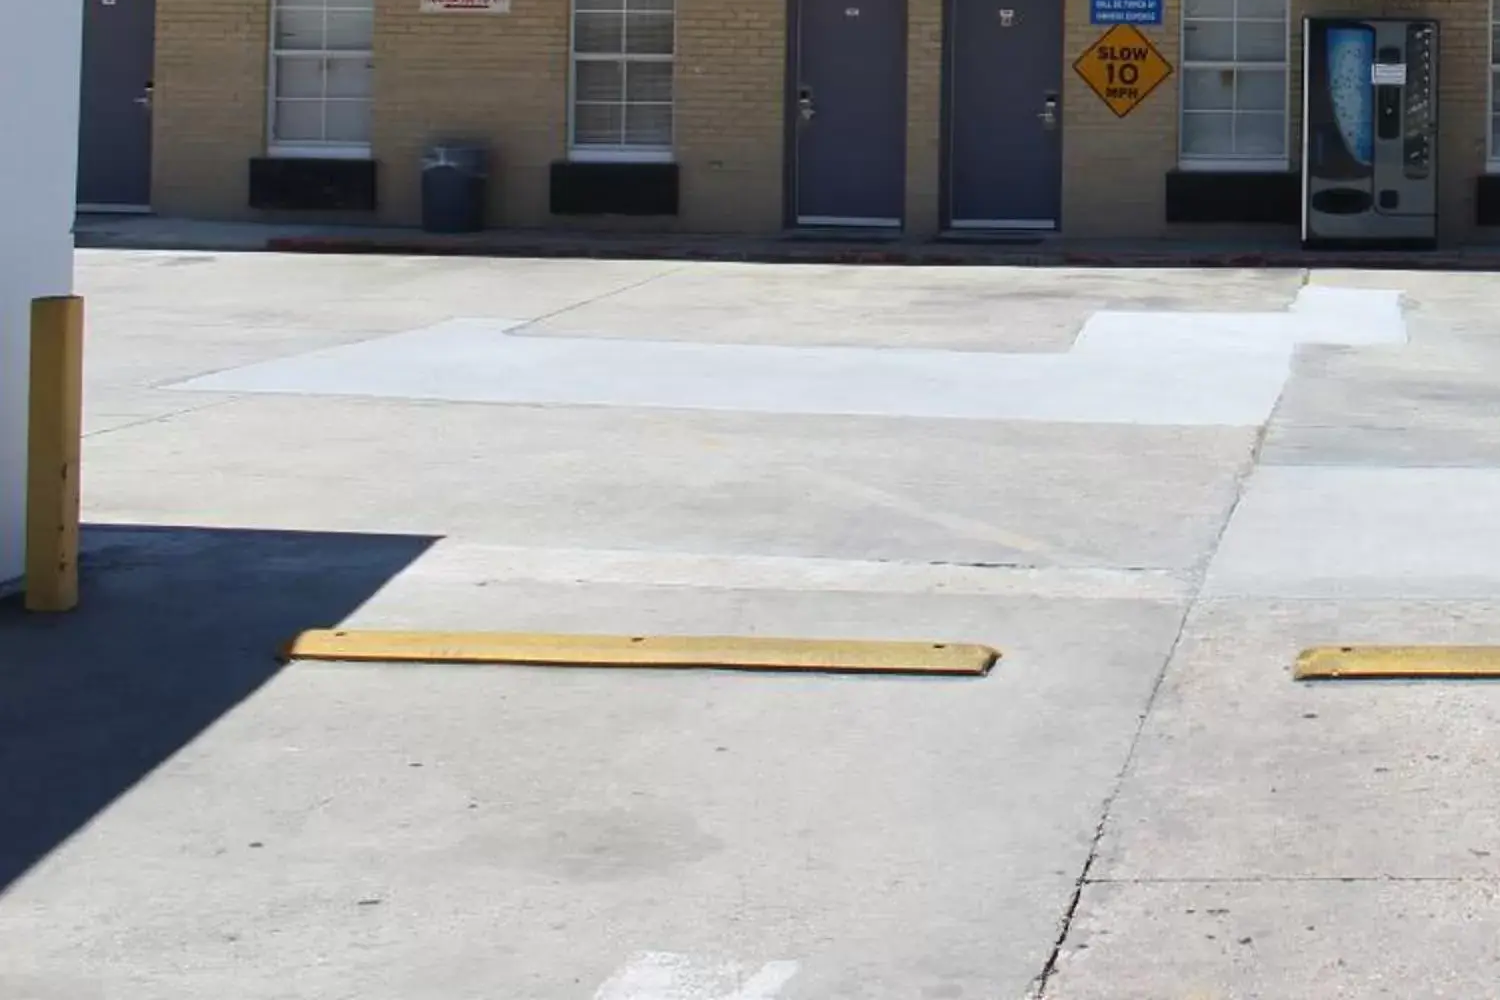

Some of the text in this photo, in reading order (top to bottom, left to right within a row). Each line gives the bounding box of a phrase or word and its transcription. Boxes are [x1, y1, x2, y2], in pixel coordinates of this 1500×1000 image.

[1097, 46, 1149, 62] SLOW
[1106, 63, 1139, 86] 10
[1105, 87, 1139, 99] MPH
